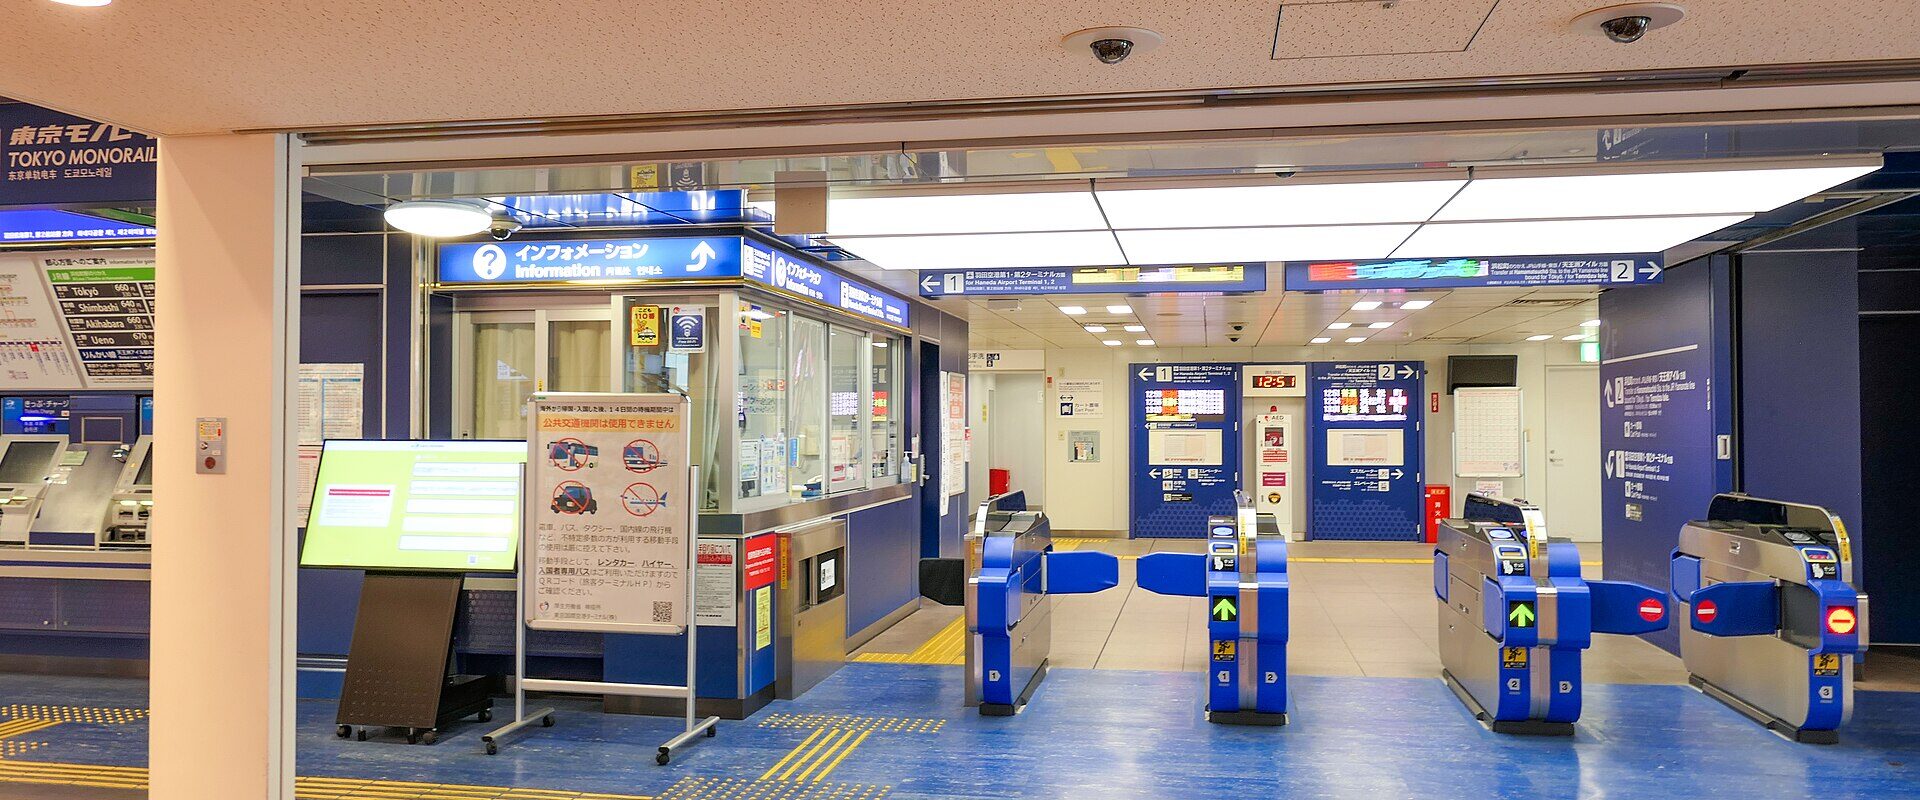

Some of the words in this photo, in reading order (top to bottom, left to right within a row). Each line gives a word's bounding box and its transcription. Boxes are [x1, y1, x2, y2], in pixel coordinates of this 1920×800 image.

[9, 122, 157, 145] 東京モノレ
[8, 149, 66, 168] TOKYO
[69, 147, 157, 165] MONORAIL
[515, 243, 649, 262] インフォメーション
[515, 263, 601, 278] Information
[1617, 263, 1629, 279] 2
[114, 283, 130, 292] 660
[950, 275, 957, 291] 1
[78, 303, 120, 313] Shimbashi
[120, 300, 136, 308] 640
[86, 317, 125, 328] Akihabara
[126, 316, 142, 325] 660
[91, 335, 115, 345] Ueno
[132, 332, 148, 341] 670
[1161, 368, 1167, 380] 1
[1382, 366, 1391, 379] 2
[1258, 376, 1296, 388] 12:51
[1617, 380, 1622, 402] 2
[543, 418, 675, 430] 公共交通機関は使用できません
